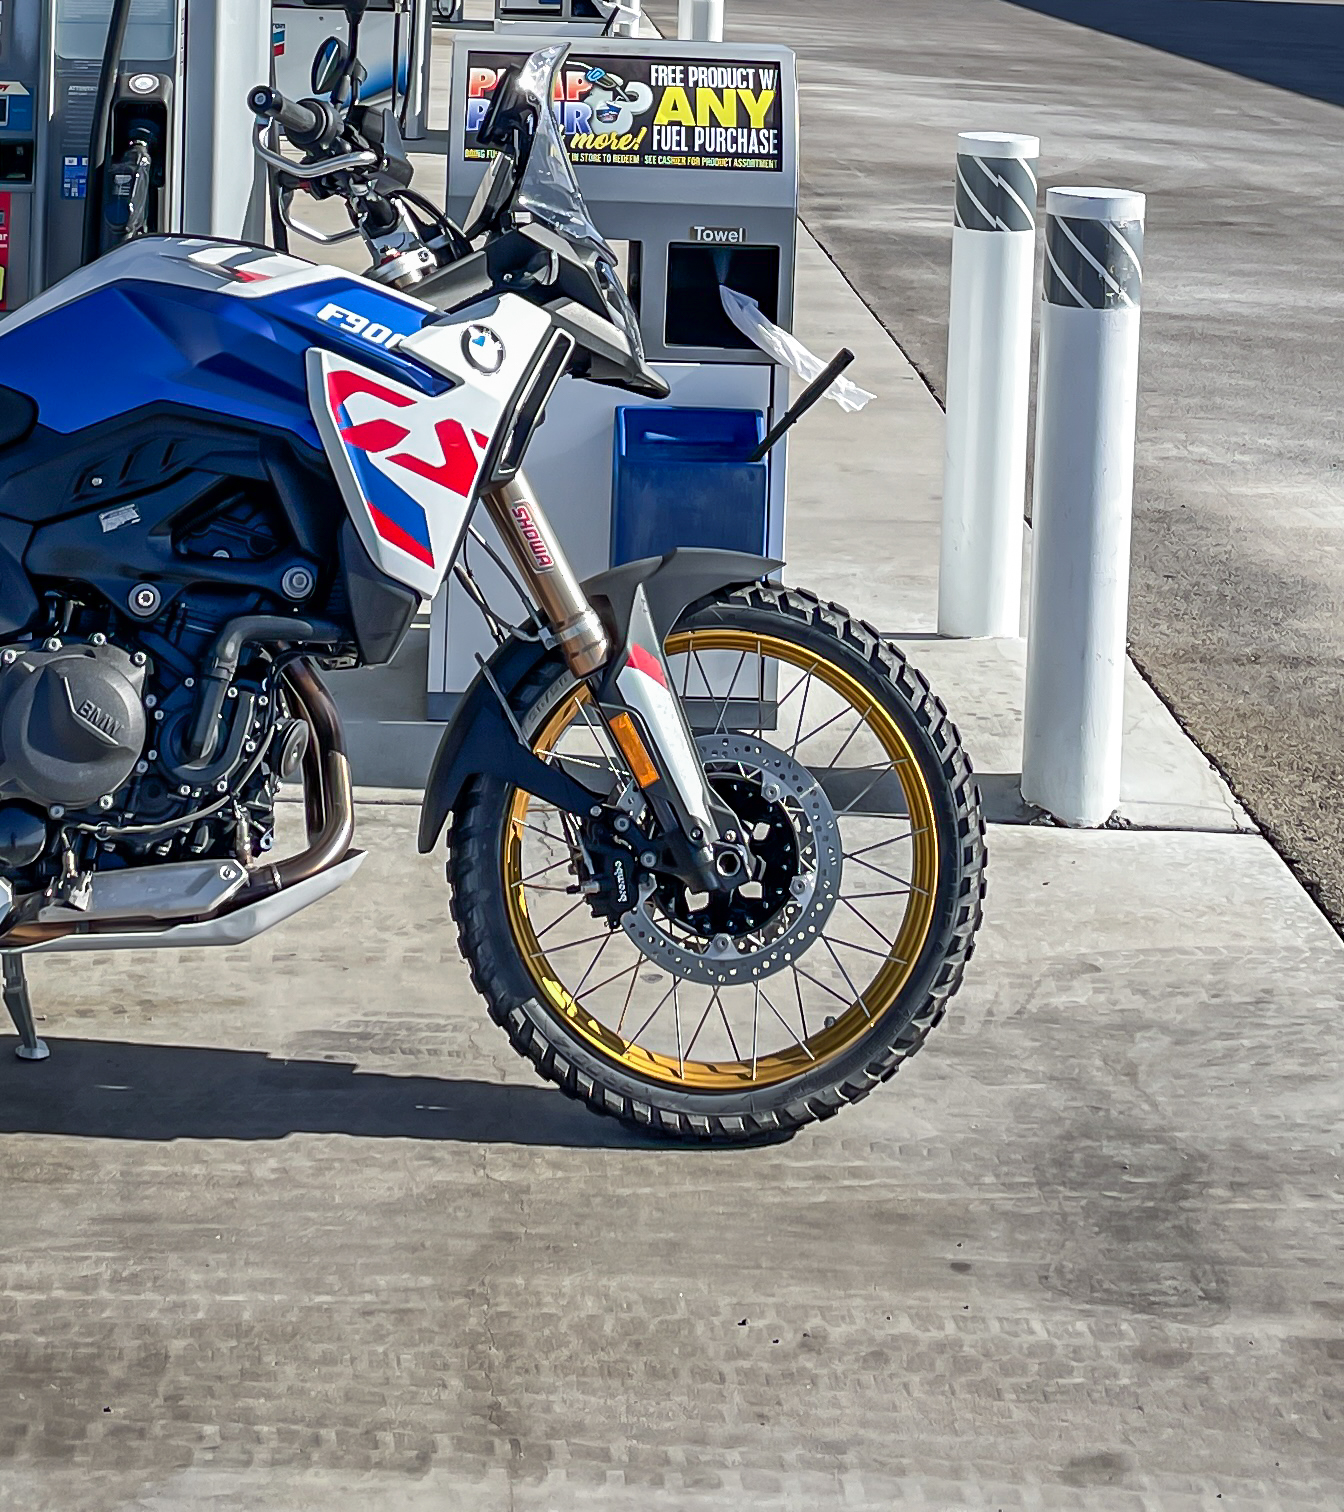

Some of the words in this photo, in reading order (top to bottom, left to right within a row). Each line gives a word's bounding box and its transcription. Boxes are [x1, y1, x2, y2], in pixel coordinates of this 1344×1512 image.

[650, 64, 684, 87] FREE
[688, 65, 753, 90] PRODUCT
[758, 68, 779, 91] W/
[654, 86, 775, 129] ANY
[570, 126, 647, 151] more!
[652, 125, 688, 152] FUEL
[694, 127, 778, 155] PURCHASE
[579, 153, 601, 163] STORE
[603, 153, 611, 163] TO
[644, 155, 657, 165] SEE
[687, 157, 701, 166] FOR
[694, 226, 744, 243] Towel
[512, 506, 552, 568] SHOWA
[76, 698, 123, 736] BMW
[613, 860, 628, 903] brembo
